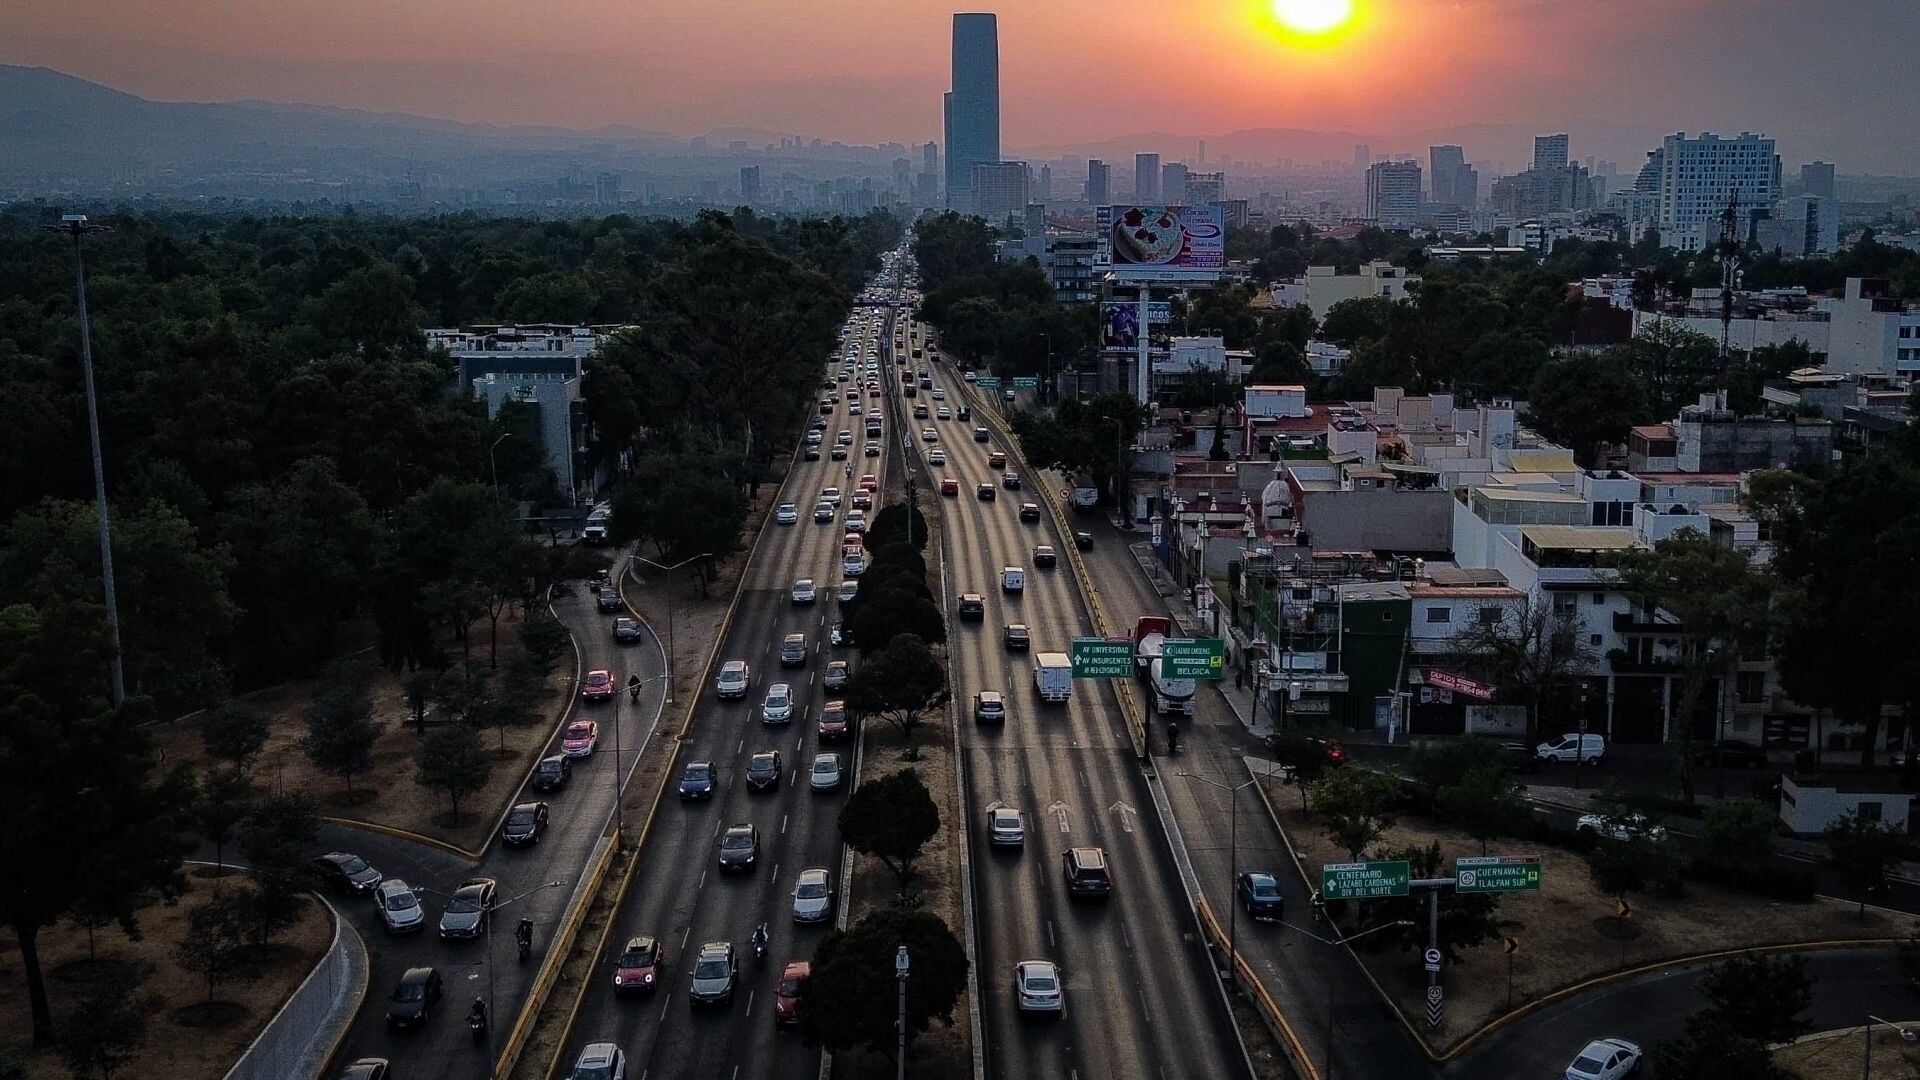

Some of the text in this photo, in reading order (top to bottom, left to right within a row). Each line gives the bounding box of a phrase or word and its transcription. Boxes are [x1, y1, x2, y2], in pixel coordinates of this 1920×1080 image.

[1082, 646, 1129, 654] AV UNIVERSIDAD
[1091, 657, 1132, 665] INSURGENTES
[1177, 667, 1210, 675] BELGICA
[1337, 870, 1382, 879] CENTENARIO
[1477, 868, 1526, 877] CUERNAVACA
[1364, 877, 1396, 887] CARDENAS
[1478, 878, 1526, 888] TLALPAN SUR
[1355, 887, 1367, 896] DEL
[1371, 887, 1392, 895] NORTE
